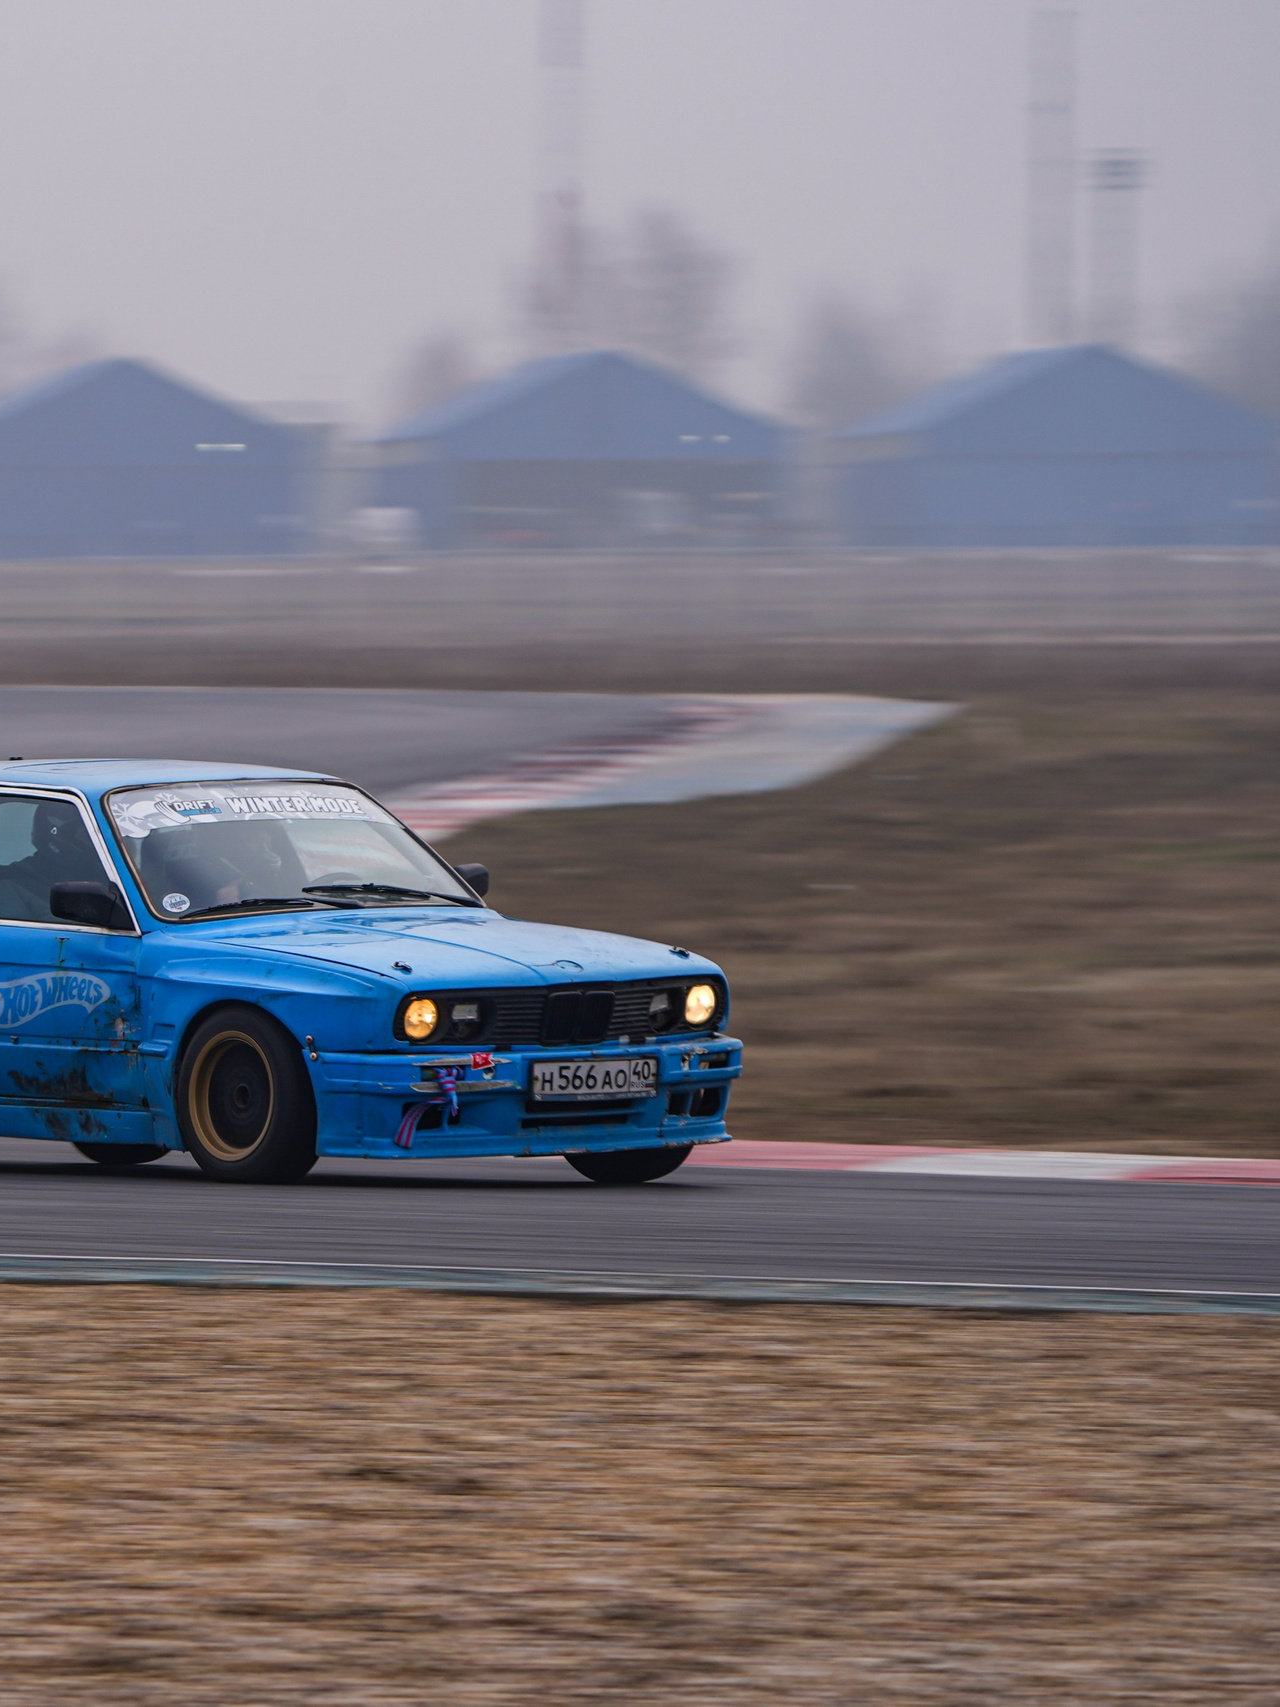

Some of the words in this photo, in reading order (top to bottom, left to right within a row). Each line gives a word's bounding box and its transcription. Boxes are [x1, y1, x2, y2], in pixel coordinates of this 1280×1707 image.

[173, 800, 215, 811] DRIFT
[224, 796, 312, 814] WINTER
[307, 797, 366, 815] MODE
[632, 1061, 651, 1080] 40
